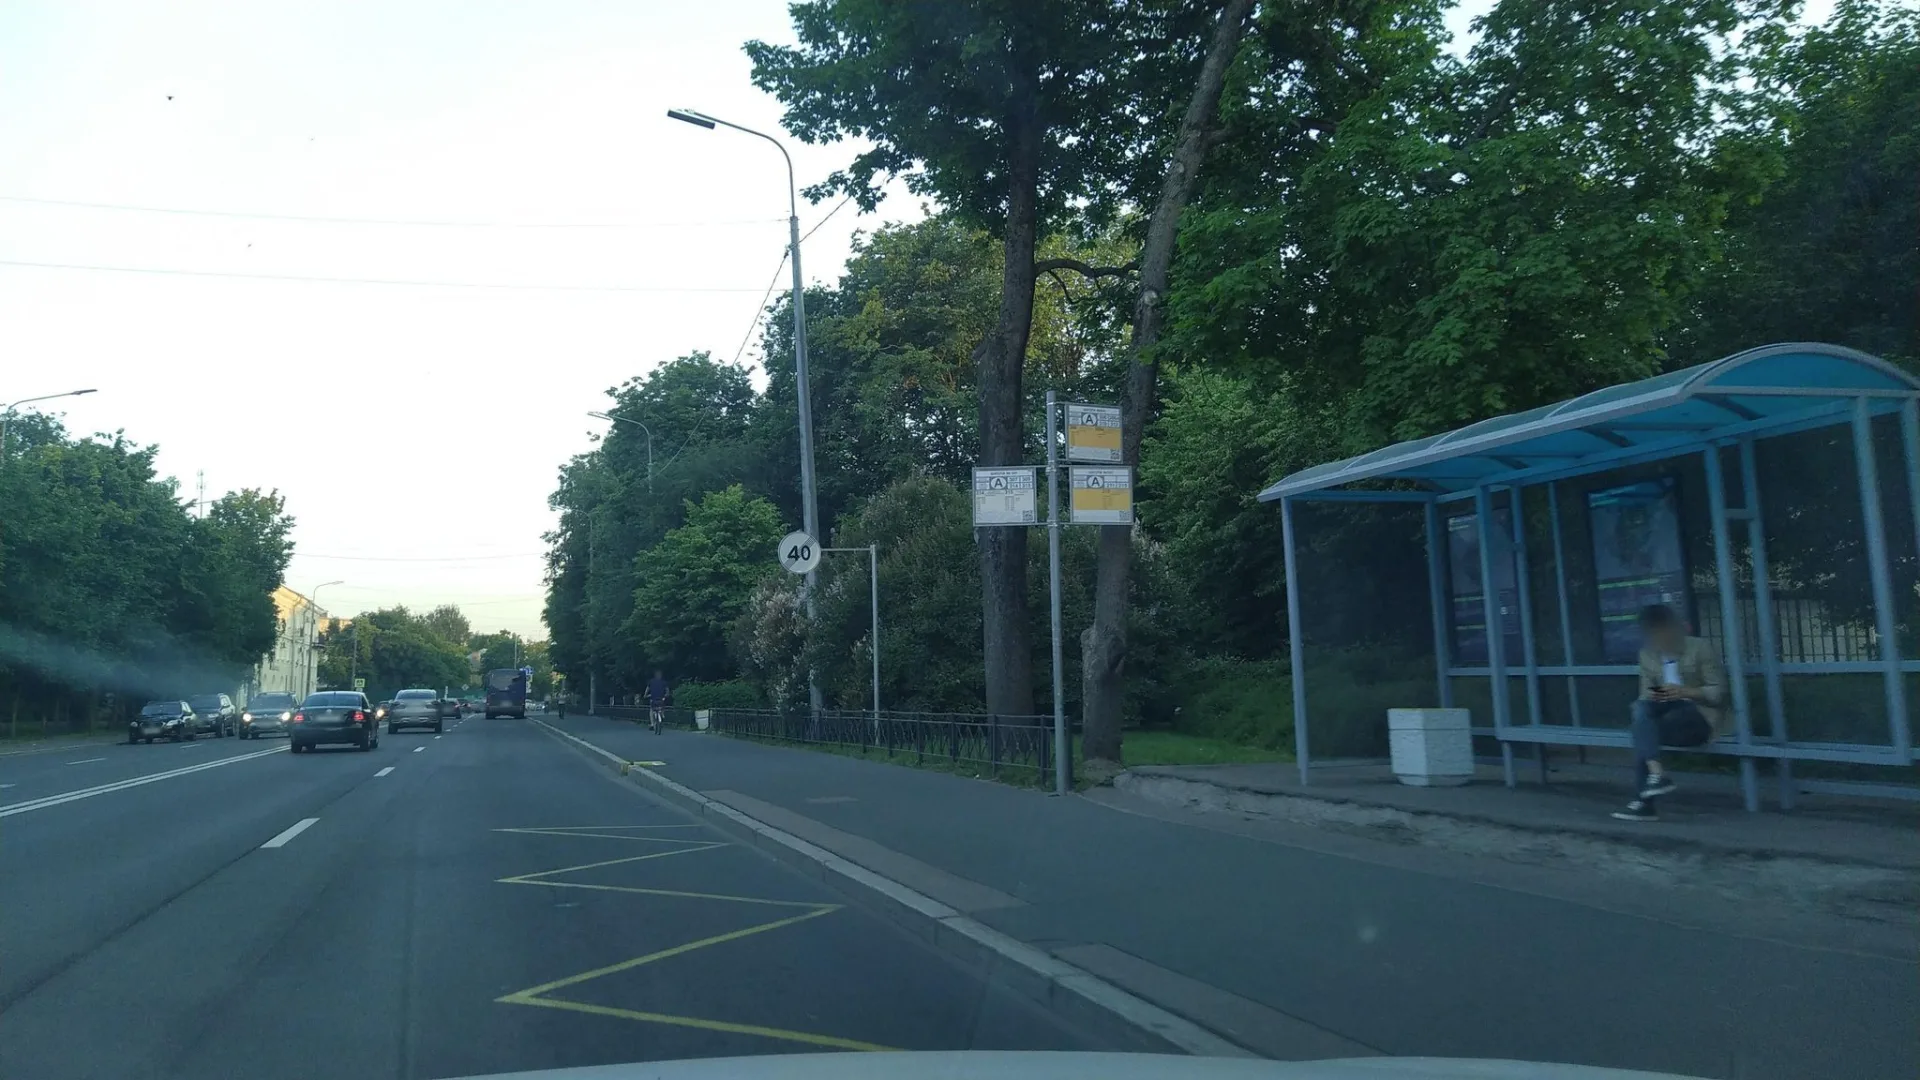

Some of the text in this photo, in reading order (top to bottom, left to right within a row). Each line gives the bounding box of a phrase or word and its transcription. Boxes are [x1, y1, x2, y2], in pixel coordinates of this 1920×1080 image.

[1085, 414, 1094, 424] А
[994, 478, 1003, 488] А
[1091, 476, 1100, 487] А
[787, 545, 811, 561] 40
